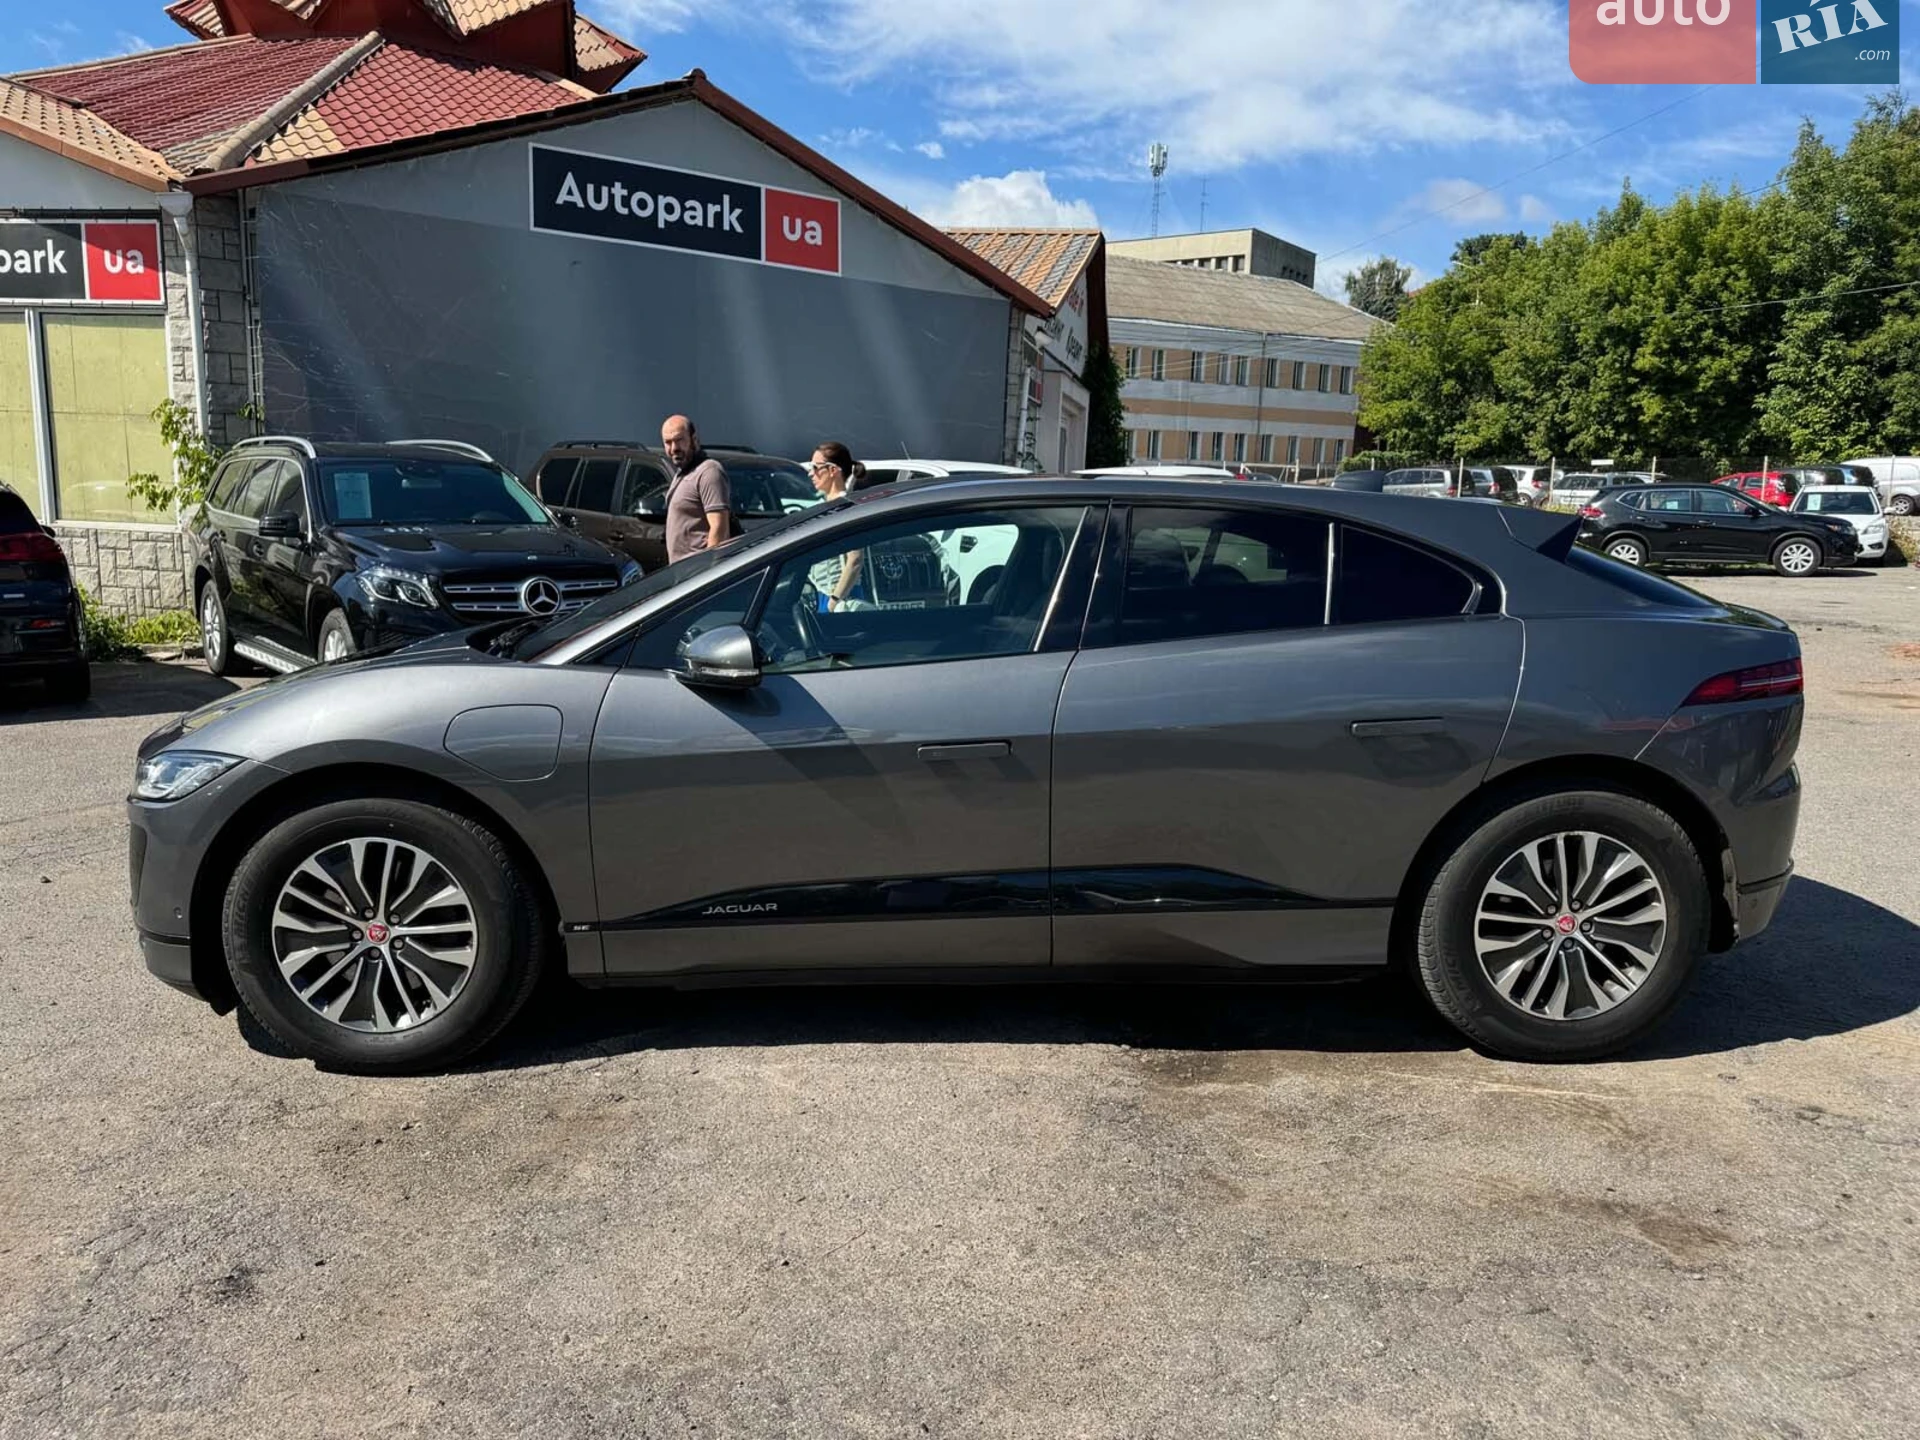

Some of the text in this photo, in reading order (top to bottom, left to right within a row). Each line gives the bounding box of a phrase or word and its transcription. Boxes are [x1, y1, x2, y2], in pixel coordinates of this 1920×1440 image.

[555, 171, 823, 246] Autopark ua
[103, 249, 145, 274] ua
[701, 902, 778, 915] JAGUAR
